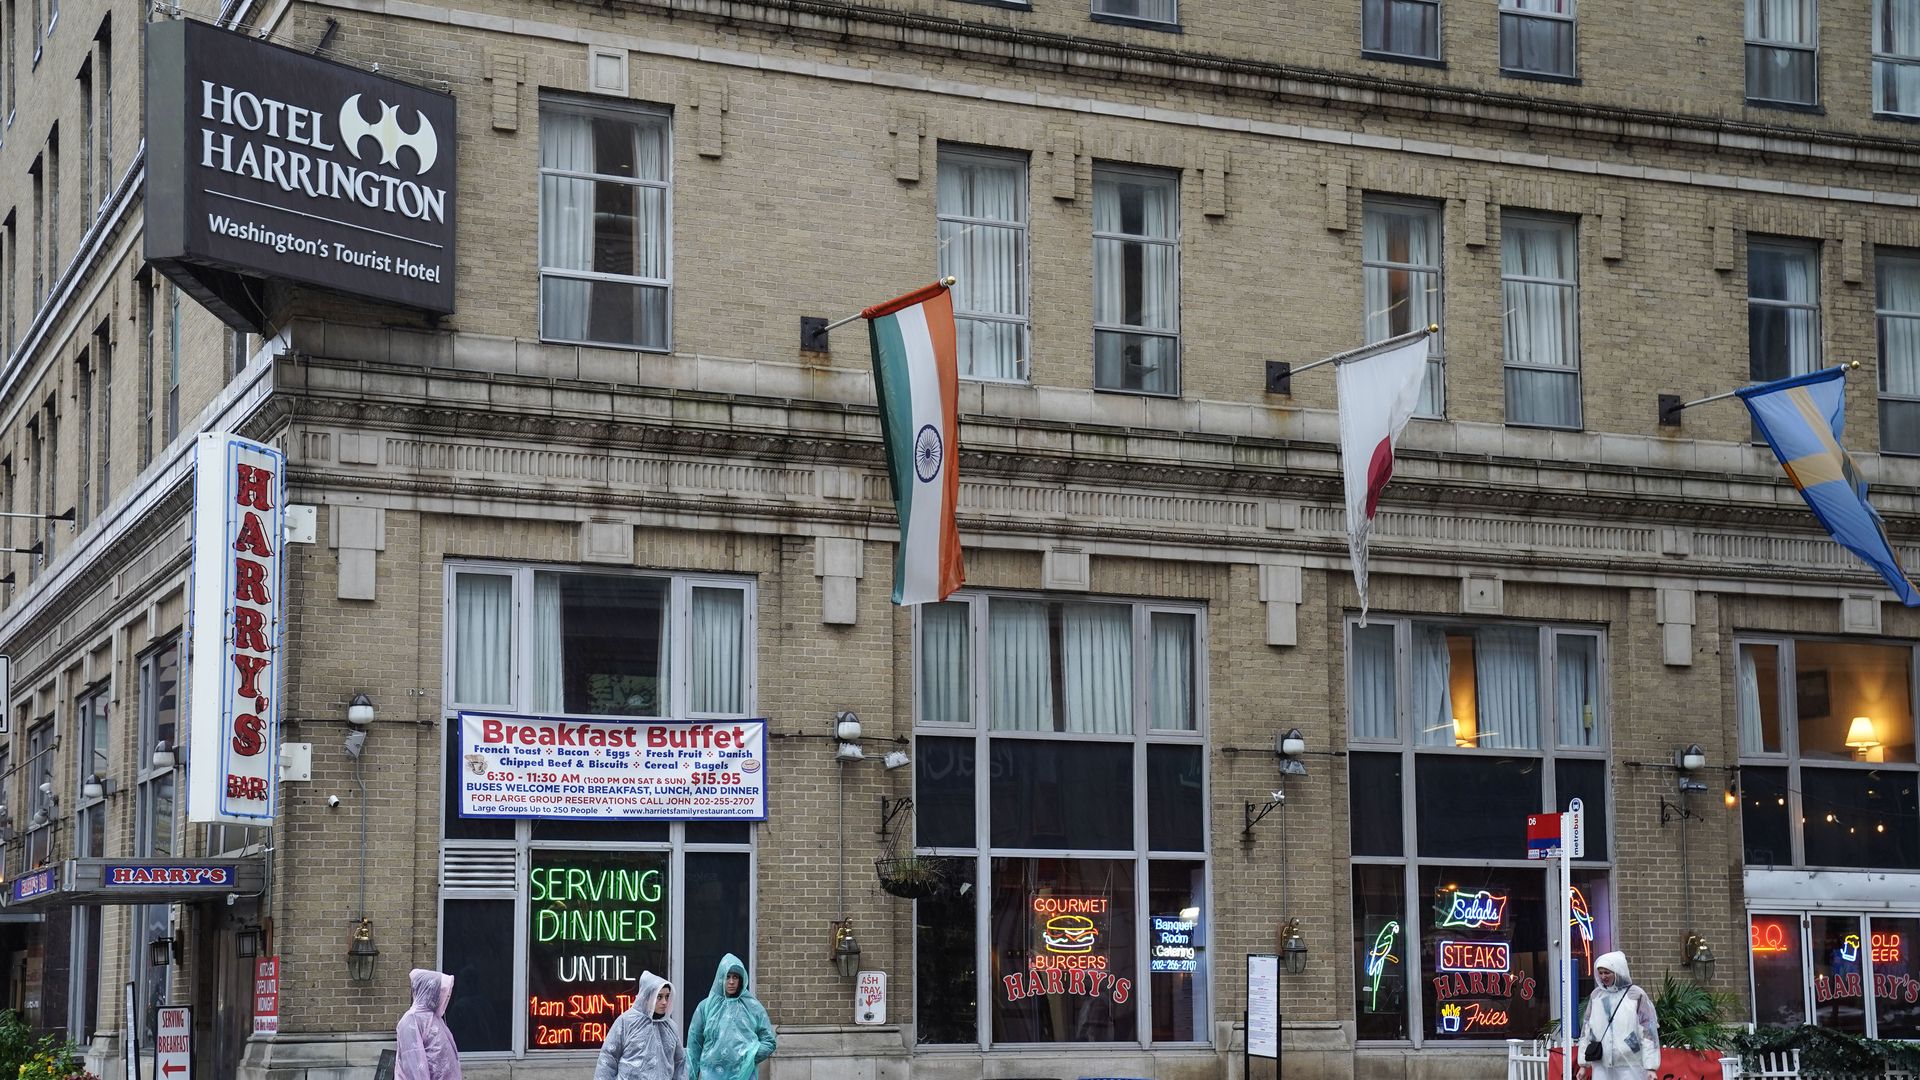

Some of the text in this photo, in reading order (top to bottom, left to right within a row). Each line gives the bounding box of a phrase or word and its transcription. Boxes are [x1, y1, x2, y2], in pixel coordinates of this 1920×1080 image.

[201, 80, 334, 151] HOTEL
[201, 128, 447, 224] HARRINGTON
[208, 213, 440, 284] Washington's Tourist Hotel
[231, 462, 275, 758] HARRY'S
[482, 719, 745, 749] Breakfast Buffet
[474, 745, 753, 760] French Toast Bacon Eggs Fresh Fruit Danish
[500, 757, 729, 772] Chipped Beef & Biscuits Cereal Bagels
[227, 774, 268, 801] BAR
[487, 772, 515, 782] 6:30
[527, 773, 557, 783] 11:30
[561, 774, 580, 784] AM
[583, 776, 606, 785] (1:00
[607, 777, 620, 785] PM
[622, 777, 636, 785] ON
[638, 777, 654, 785] SAT
[656, 777, 662, 785] &
[665, 777, 687, 786] SUN)
[691, 771, 741, 786] $15.95
[466, 783, 759, 796] BUSES WELCOME FOR BREAKFAST, LUNCH, AND DINNER
[471, 794, 755, 806] FOR LARGE GROUP RESERVATIONS CALL JOHN 202-255-2707
[472, 805, 754, 816] Large Groups Up to 250 People www.harrietsfamilyrestaurant.com
[113, 868, 227, 884] HARRY'S
[530, 867, 662, 902] SERVING
[1033, 898, 1108, 913] GOURMET
[1453, 898, 1499, 920] Salads
[537, 909, 657, 942] DINNER
[1155, 918, 1193, 933] Banquet
[1161, 932, 1189, 944] Room
[1871, 934, 1900, 948] OLD
[1156, 945, 1195, 959] Catering
[1443, 945, 1507, 969] STEAKS
[1871, 948, 1899, 962] EER
[558, 955, 637, 983] UNTIL
[1034, 955, 1107, 970] BURGERS
[862, 976, 879, 985] ASH
[1002, 967, 1132, 1004] HARRY'S
[1433, 970, 1537, 1001] HARRY'S
[1814, 972, 1920, 1004] HARRY'S
[860, 986, 881, 995] TRAY
[530, 995, 564, 1017] 1am
[569, 994, 605, 1016] SUN
[162, 1010, 185, 1028] SERVING
[1464, 1003, 1509, 1032] Fries
[537, 1022, 607, 1045] 2am FRI
[158, 1035, 189, 1054] BREAKFAST
